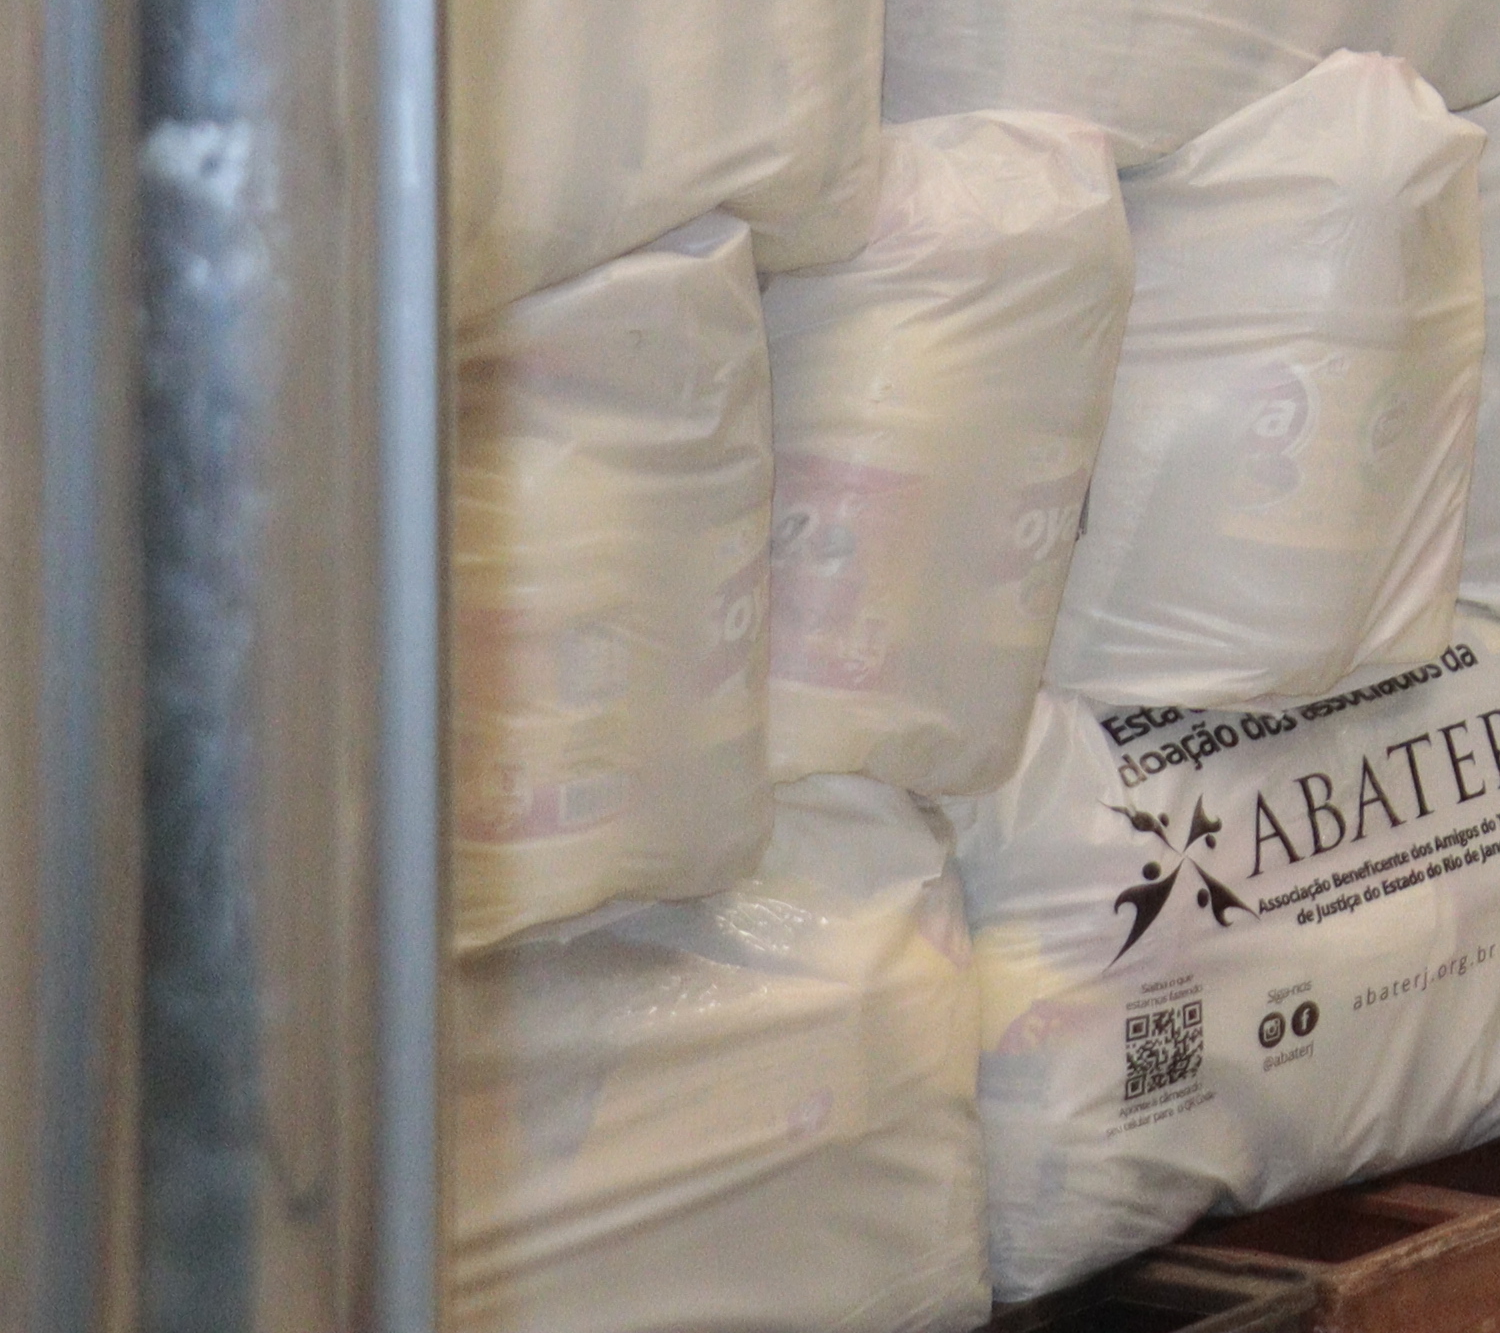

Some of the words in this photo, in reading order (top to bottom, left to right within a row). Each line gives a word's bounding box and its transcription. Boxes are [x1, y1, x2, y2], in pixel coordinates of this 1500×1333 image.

[1101, 707, 1185, 747] Esta
[1117, 718, 1241, 789] doação
[1440, 643, 1478, 676] da
[1257, 878, 1332, 915] Associação
[1332, 851, 1411, 890] Beneficente
[1410, 842, 1435, 866] dos
[1434, 825, 1481, 856] Amigos
[1481, 816, 1497, 836] do
[1296, 907, 1315, 926] de
[1315, 892, 1363, 922] Justiça
[1363, 886, 1382, 905] do
[1382, 870, 1426, 897] Estado
[1426, 862, 1444, 883] do
[1444, 852, 1464, 875] Rio
[1463, 847, 1481, 868] de
[1351, 942, 1497, 1011] abaterj.org.br
[1261, 1043, 1316, 1072] @abaterj
